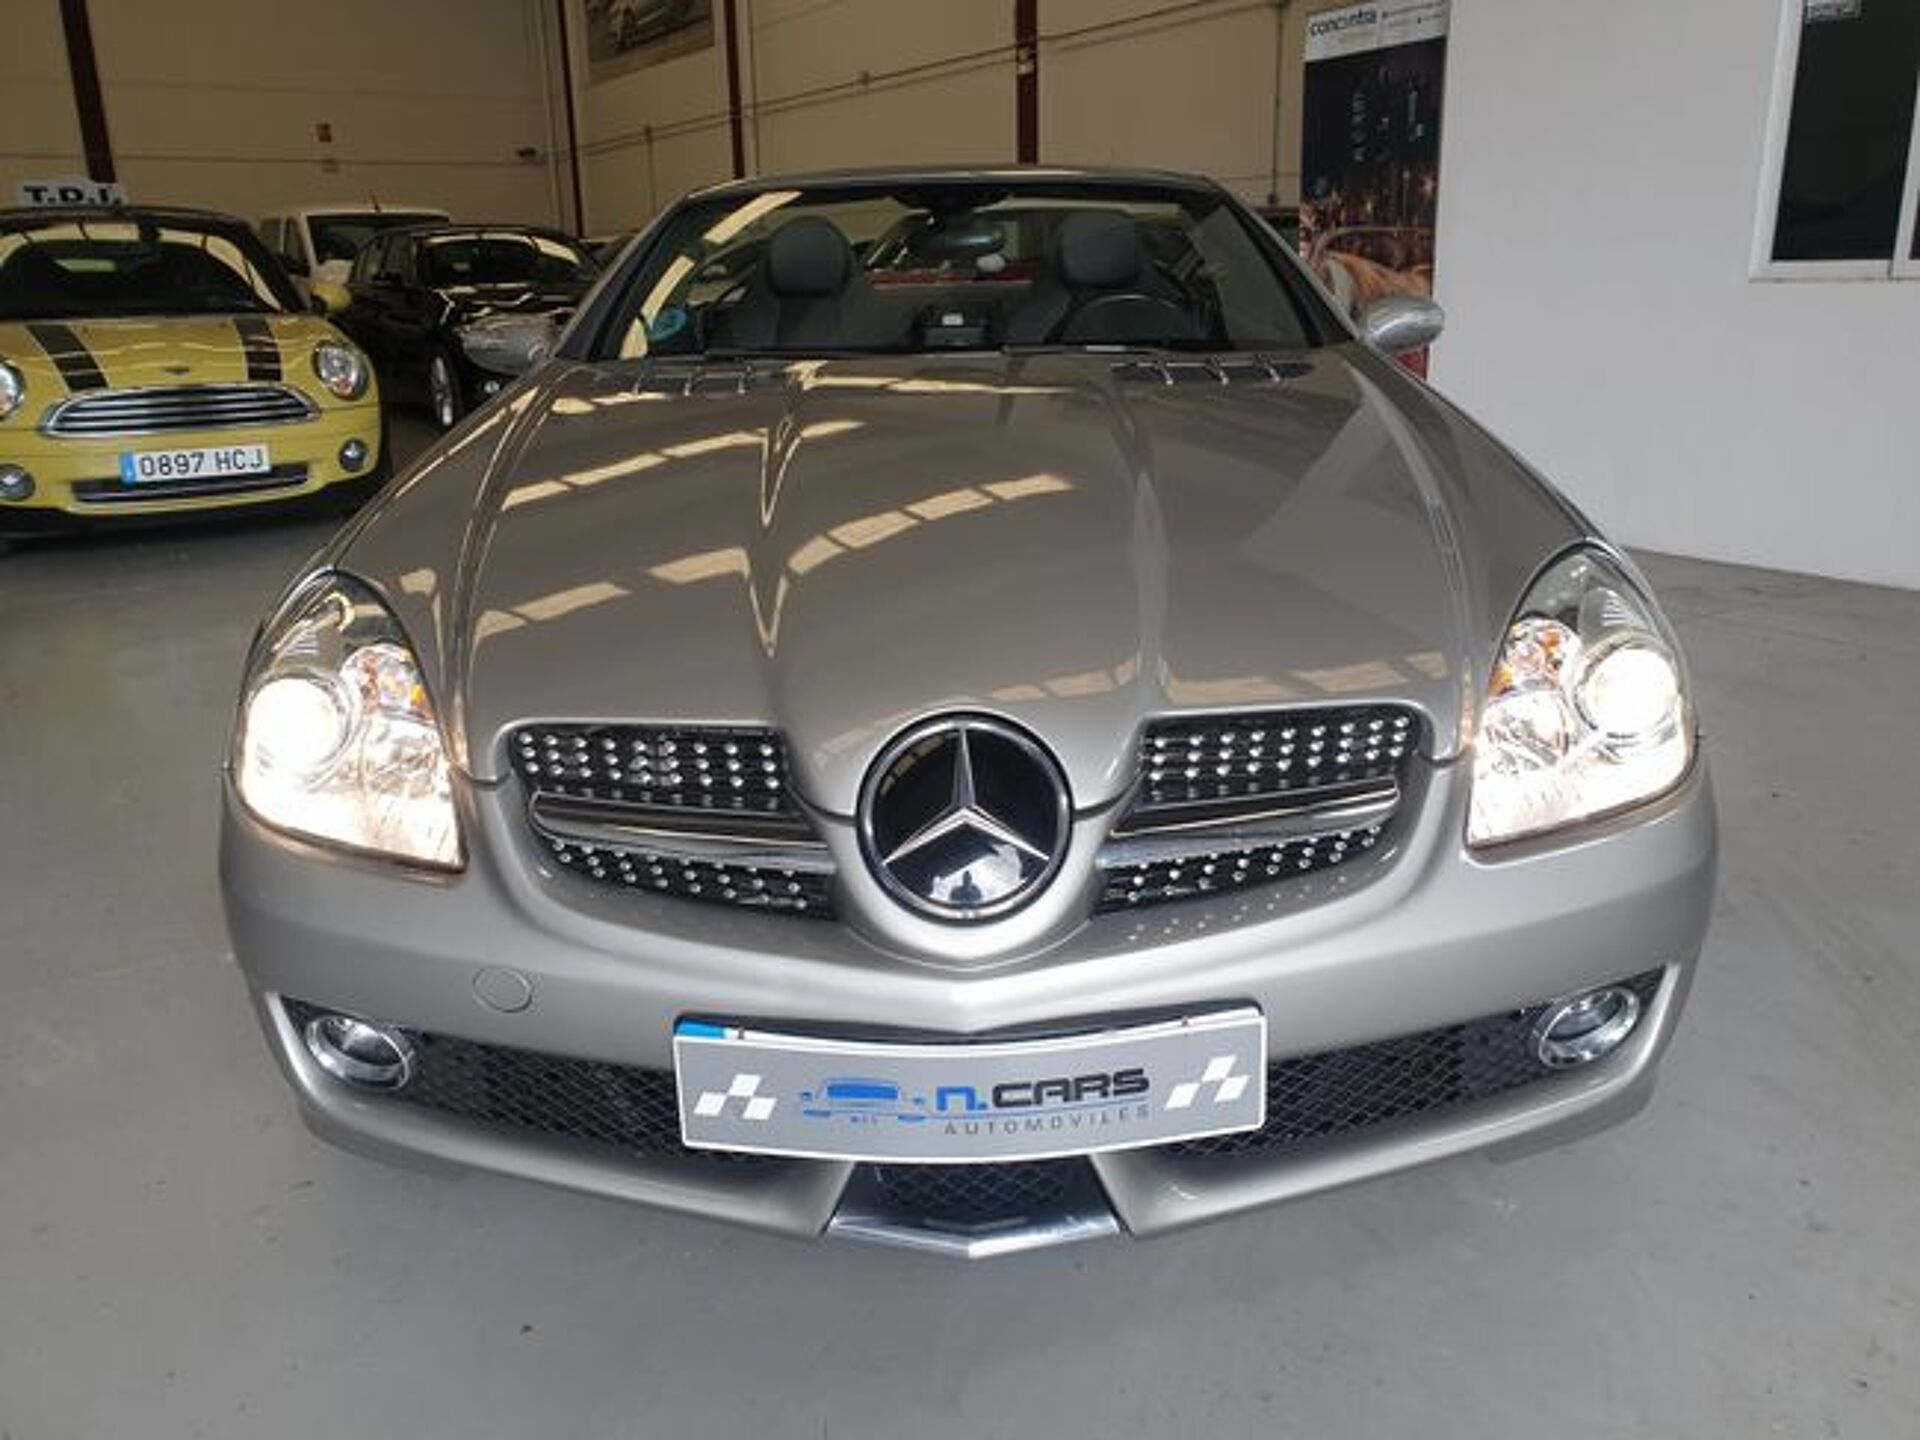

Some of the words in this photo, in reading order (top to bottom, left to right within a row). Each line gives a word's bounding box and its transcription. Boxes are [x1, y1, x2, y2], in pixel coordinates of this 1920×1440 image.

[139, 452, 205, 476] 0897
[215, 448, 264, 471] HCJ
[944, 1104, 1149, 1135] AUTOMOVILES
